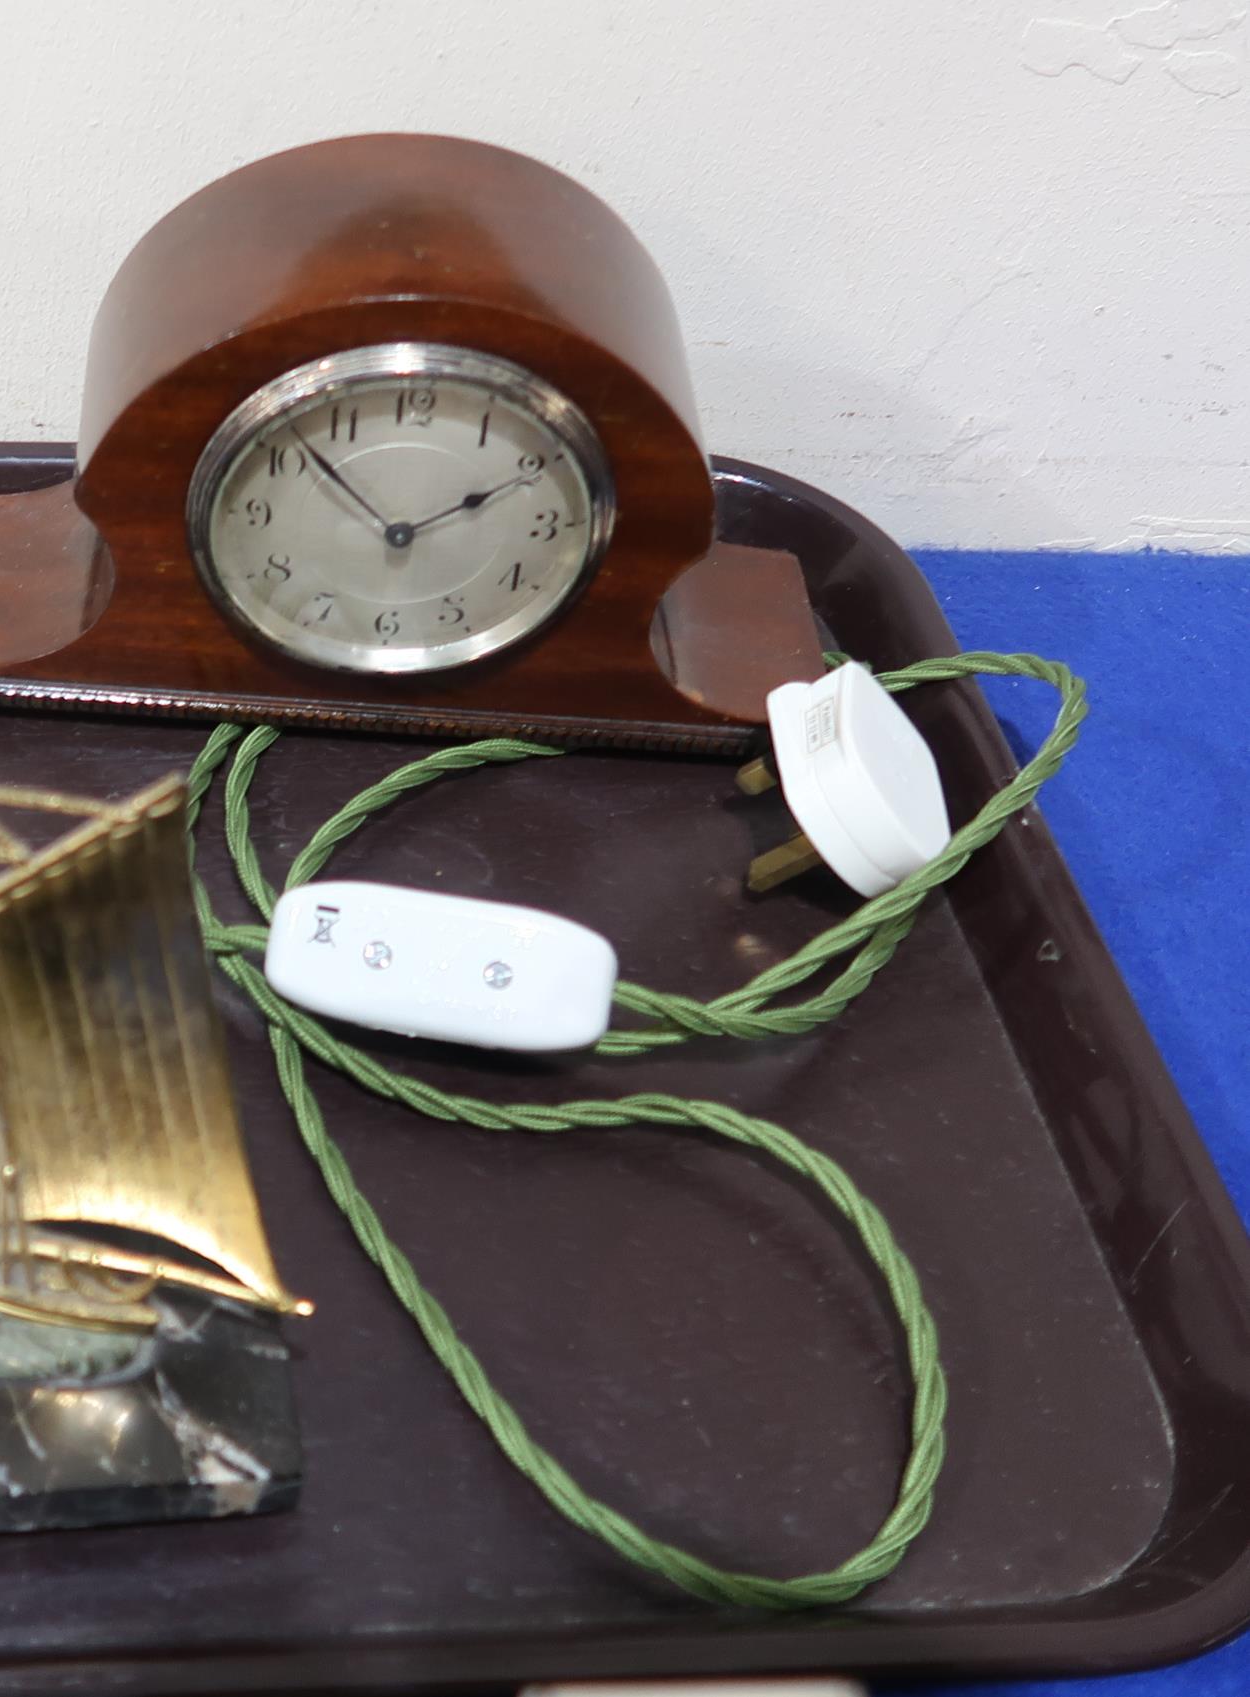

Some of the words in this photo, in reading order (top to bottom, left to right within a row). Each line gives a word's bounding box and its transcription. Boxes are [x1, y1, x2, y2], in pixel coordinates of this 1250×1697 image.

[330, 405, 358, 442] 11
[395, 389, 436, 427] 12
[477, 412, 490, 448] 1
[269, 445, 306, 478] 10
[517, 453, 545, 485] 2
[245, 498, 272, 529] 9
[530, 509, 559, 542] 3
[263, 552, 291, 583] 8
[498, 560, 526, 593] 4
[313, 592, 335, 620] 7
[438, 596, 466, 626] 5
[374, 611, 400, 640] 6
